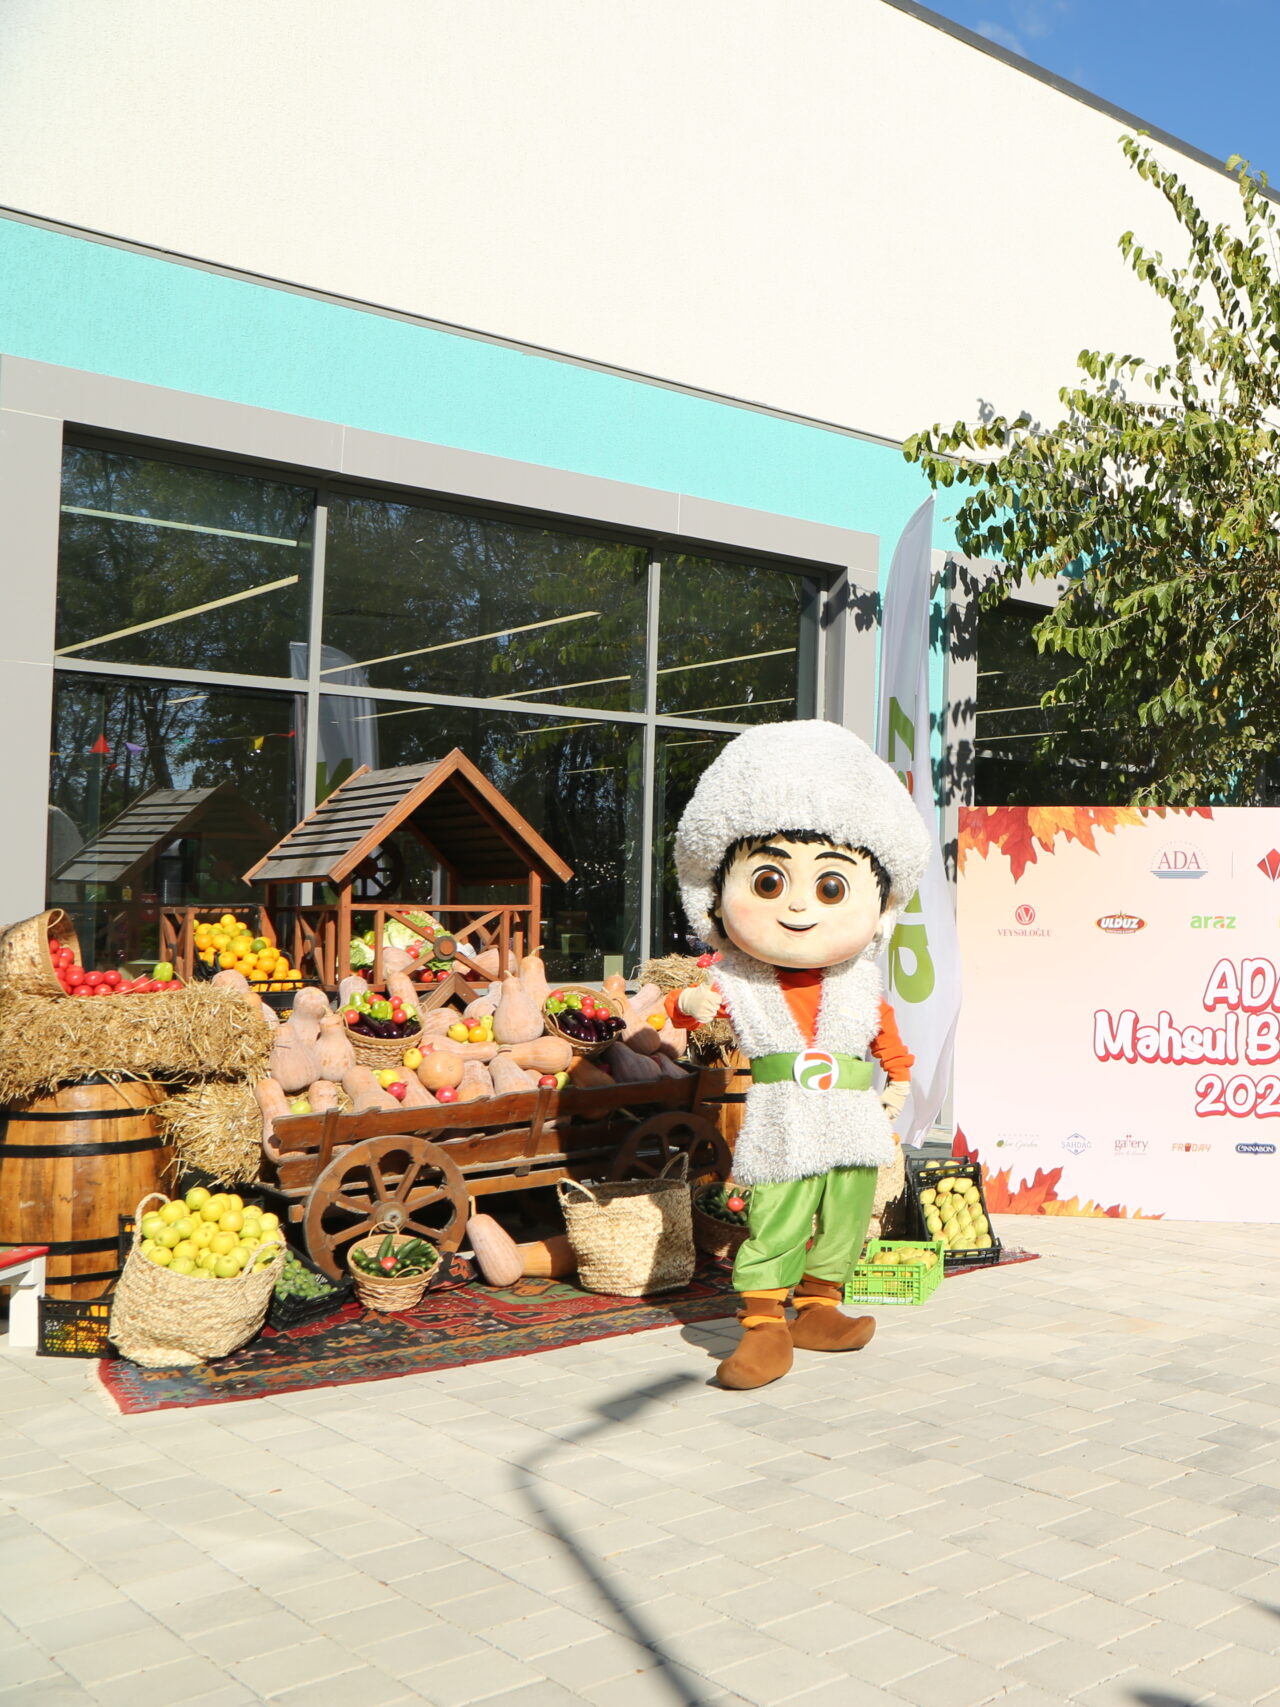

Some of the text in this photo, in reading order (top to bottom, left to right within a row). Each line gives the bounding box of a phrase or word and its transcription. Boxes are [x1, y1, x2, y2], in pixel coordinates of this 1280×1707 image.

[1158, 850, 1201, 870] ADA
[1100, 918, 1141, 929] ULDUZ
[1190, 915, 1236, 929] araz
[997, 927, 1052, 937] VEYSƏLOĞLU
[1094, 1009, 1239, 1064] Məhsul
[1237, 1144, 1274, 1153] CINNABON
